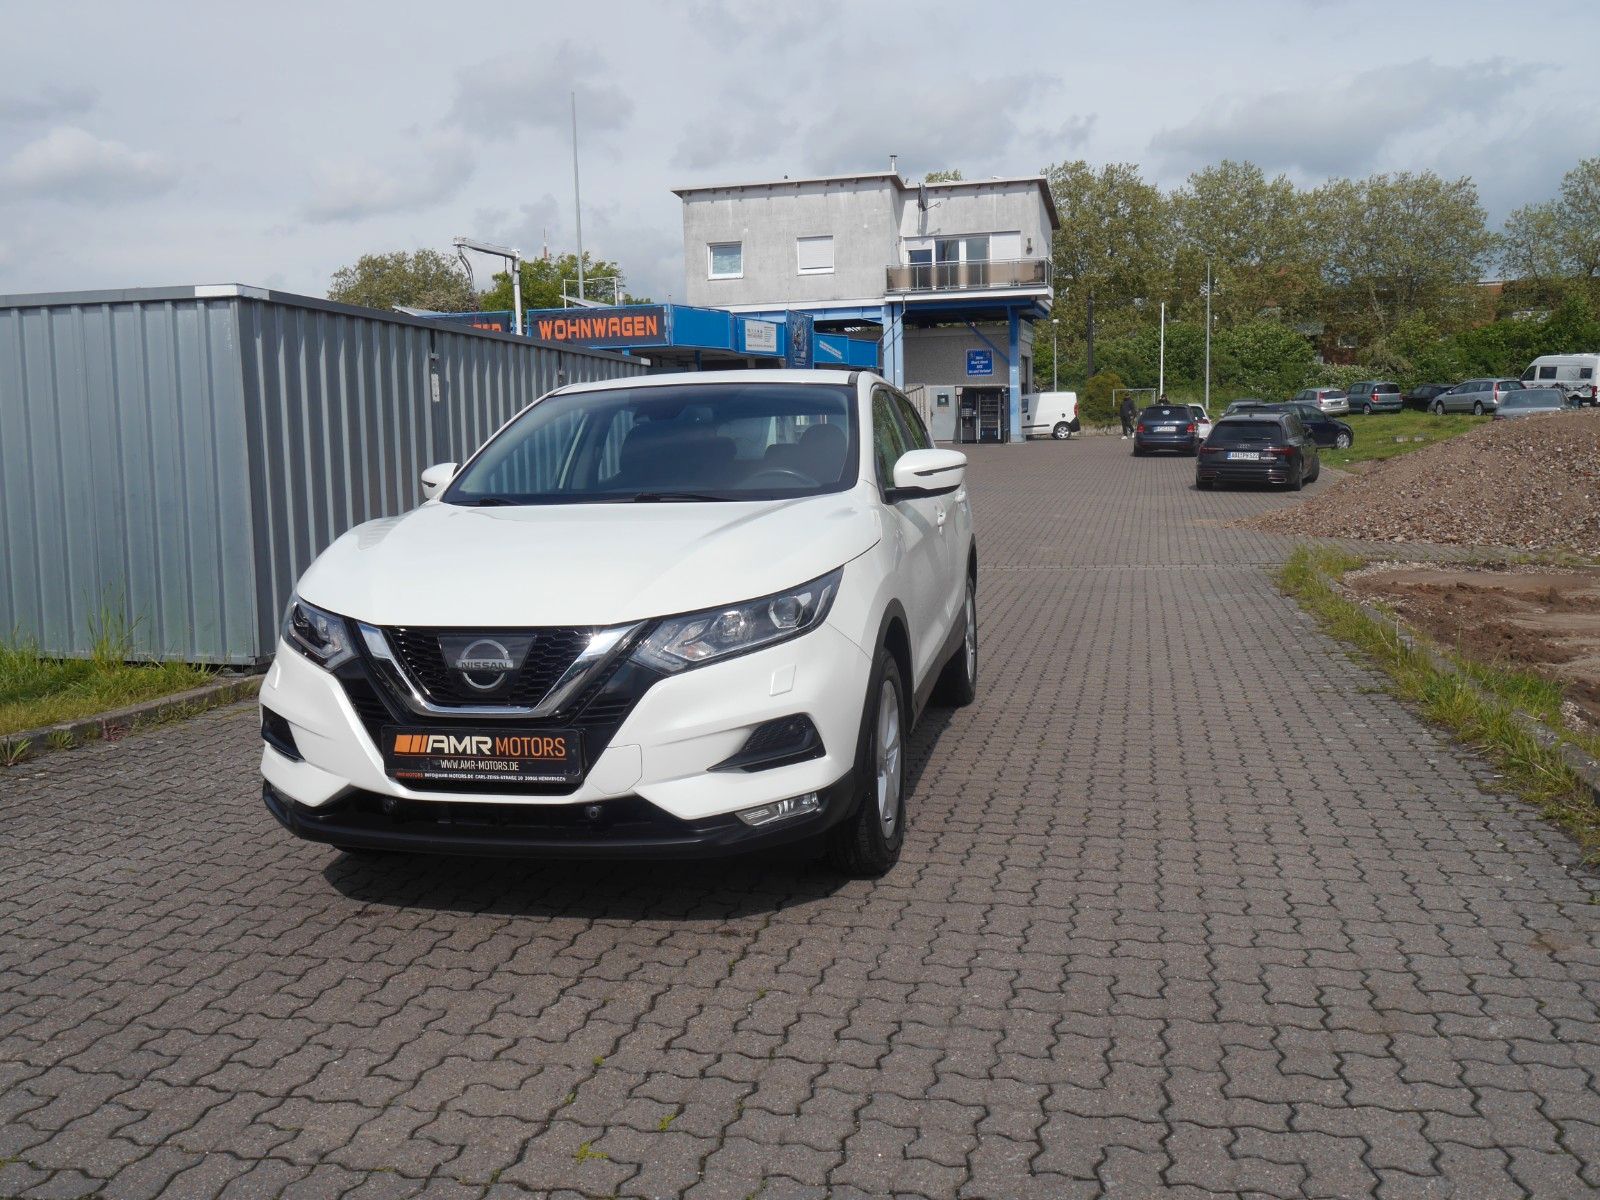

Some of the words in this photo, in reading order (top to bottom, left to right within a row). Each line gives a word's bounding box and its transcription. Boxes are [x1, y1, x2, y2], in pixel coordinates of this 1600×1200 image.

[538, 315, 658, 341] WOHNWAGEN
[461, 660, 507, 670] NISSAN
[426, 735, 493, 755] AMR
[496, 737, 566, 757] MOTORS
[440, 759, 520, 771] WWW.AMR-MOTORS.DE
